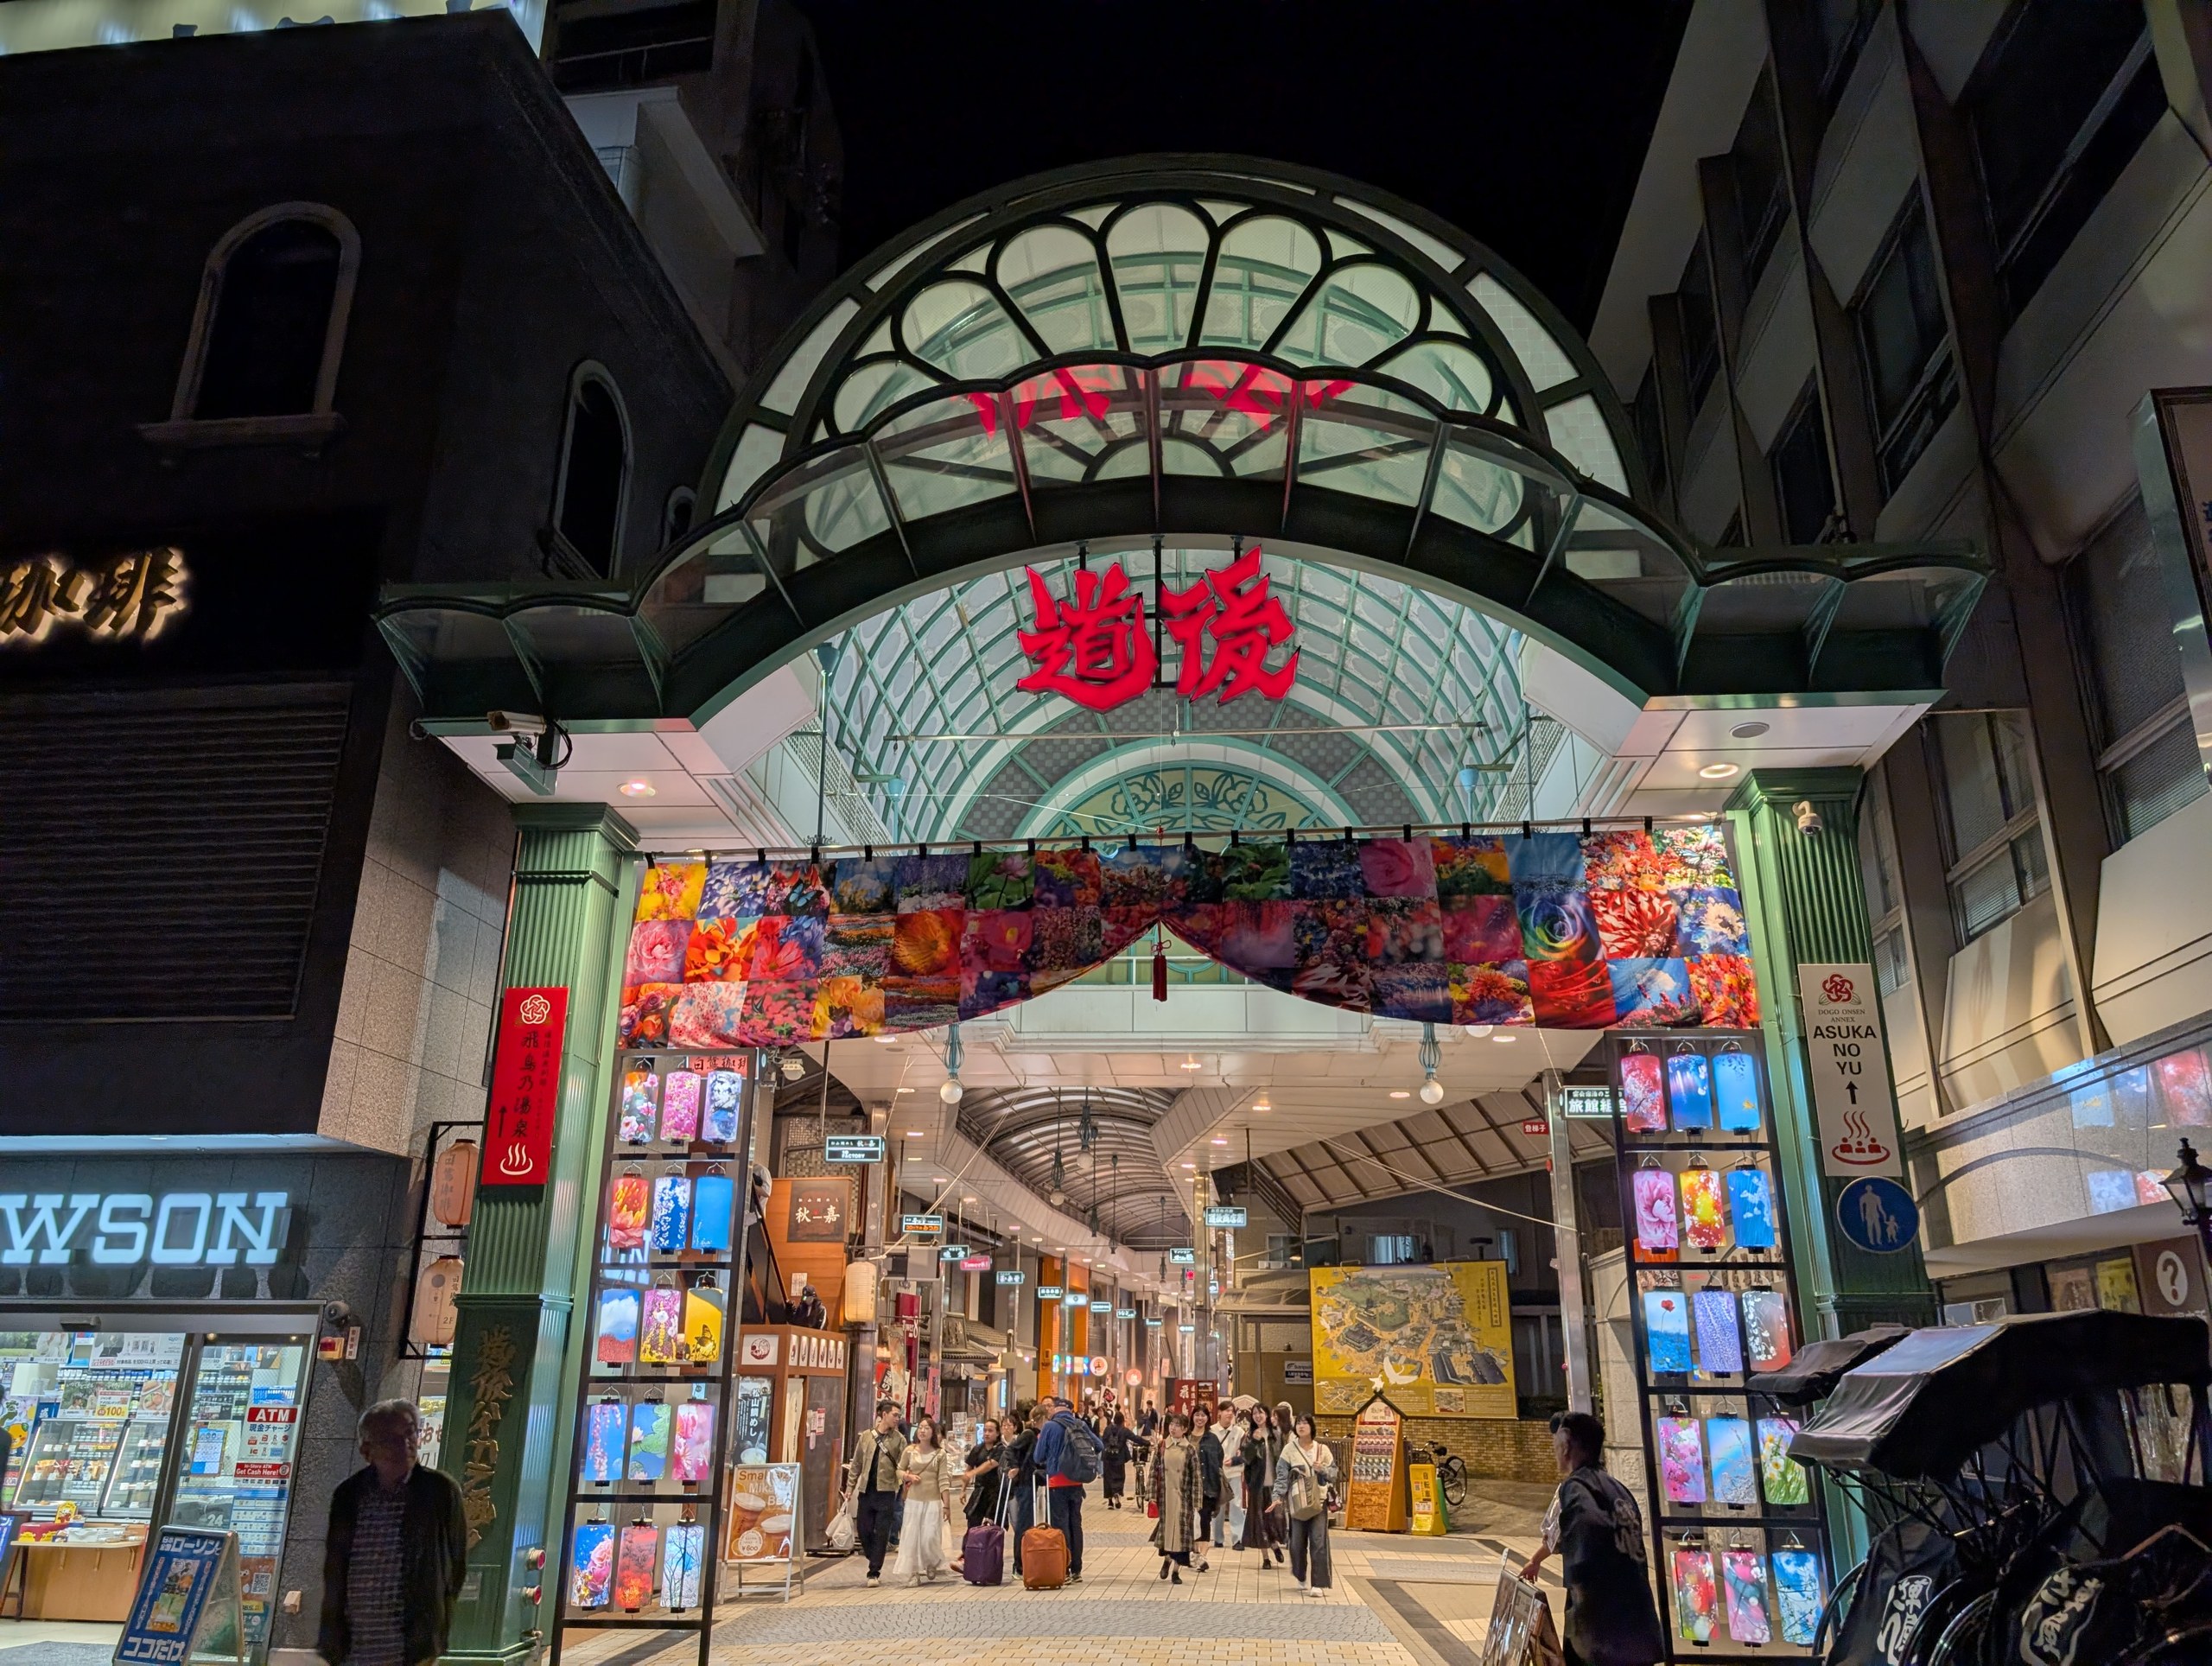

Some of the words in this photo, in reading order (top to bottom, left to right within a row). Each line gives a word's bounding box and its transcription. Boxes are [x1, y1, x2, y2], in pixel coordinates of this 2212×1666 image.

[1016, 545, 1301, 713] 道後
[1813, 1025, 1877, 1040] ASUKA
[1833, 1043, 1861, 1058] NO
[1836, 1061, 1862, 1076] YU
[512, 1030, 540, 1138] 飛鳥乃湯泉
[0, 1193, 289, 1264] WSON
[442, 1316, 454, 1325] 2F
[255, 1408, 290, 1422] ATM
[249, 1424, 292, 1433] 現金チャージ
